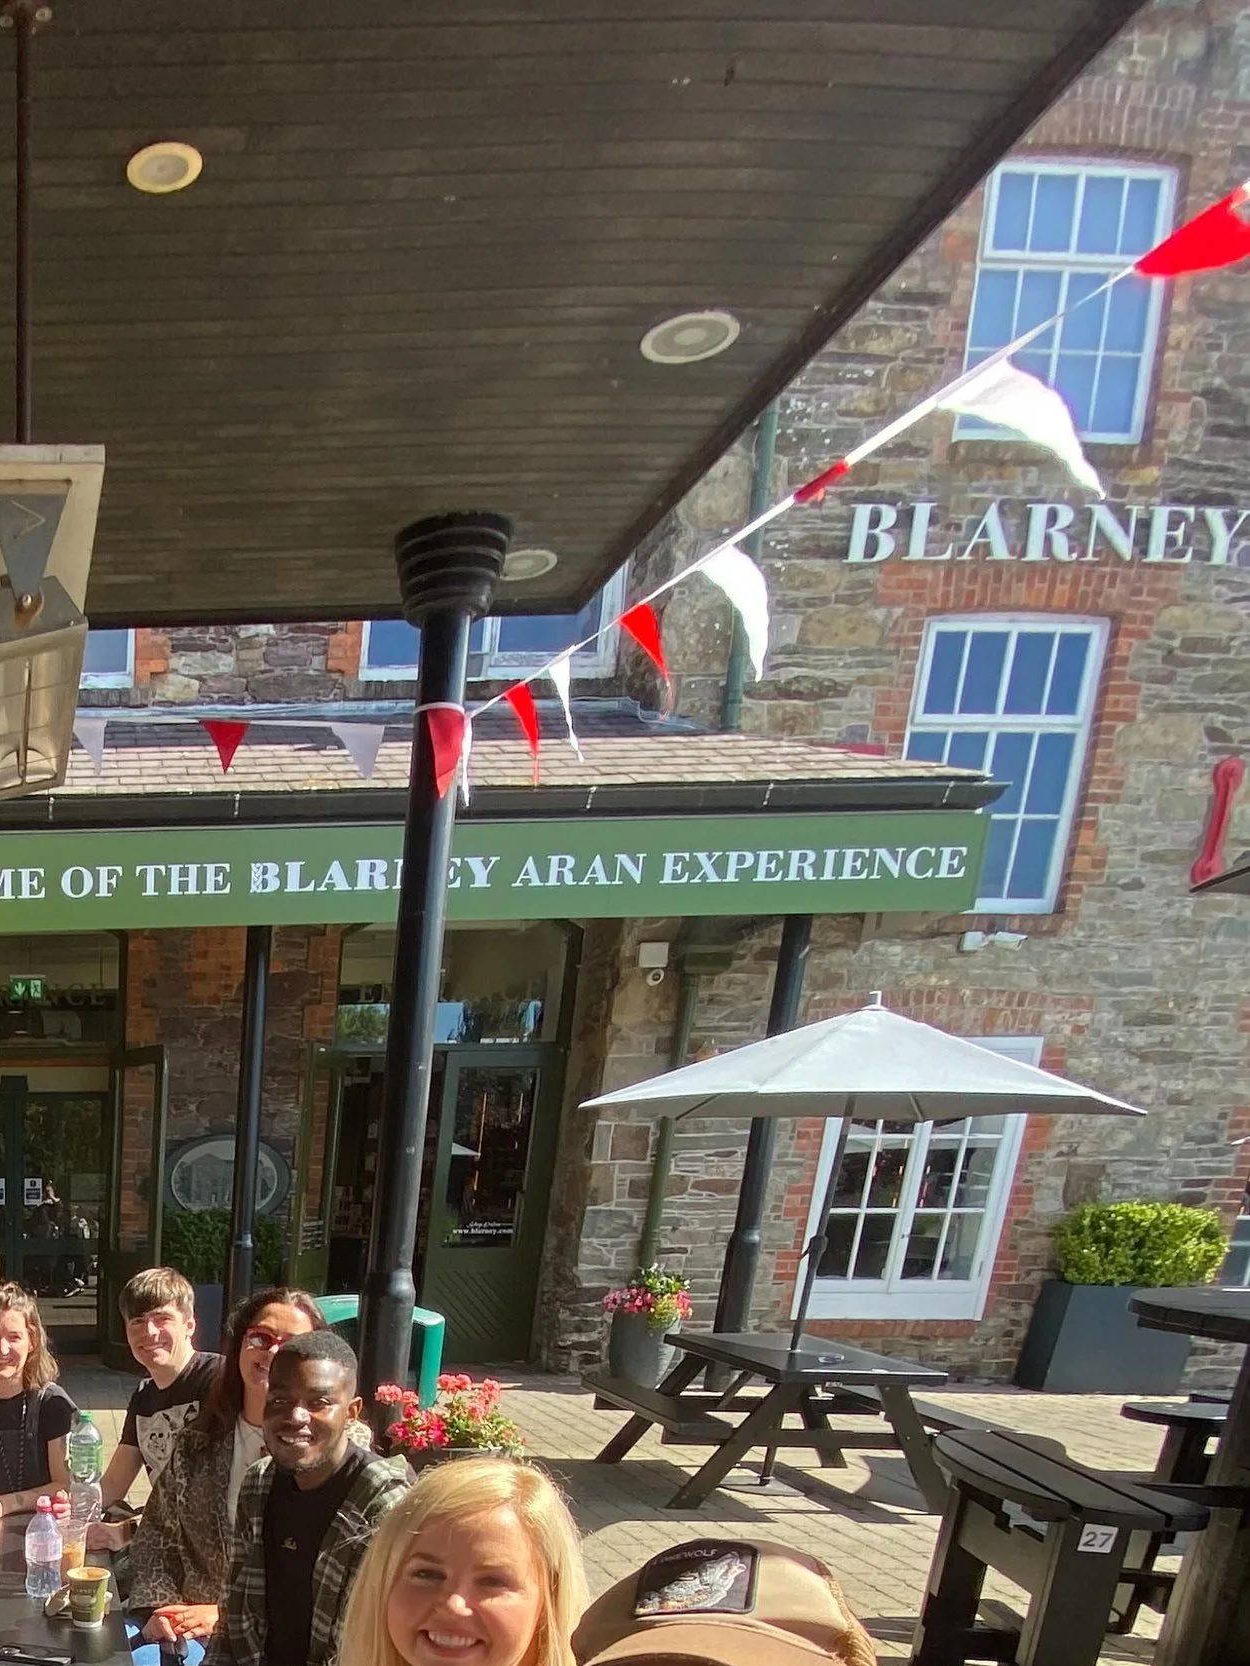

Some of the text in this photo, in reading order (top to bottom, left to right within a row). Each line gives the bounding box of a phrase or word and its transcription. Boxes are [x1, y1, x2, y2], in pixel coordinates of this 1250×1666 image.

[842, 501, 1250, 565] BLARNEY
[61, 865, 123, 898] OF
[135, 863, 232, 896] THE
[250, 856, 500, 893] BLAREY
[512, 853, 647, 888] ARAN
[659, 846, 968, 884] EXPERIENCE
[1082, 1531, 1114, 1548] 27
